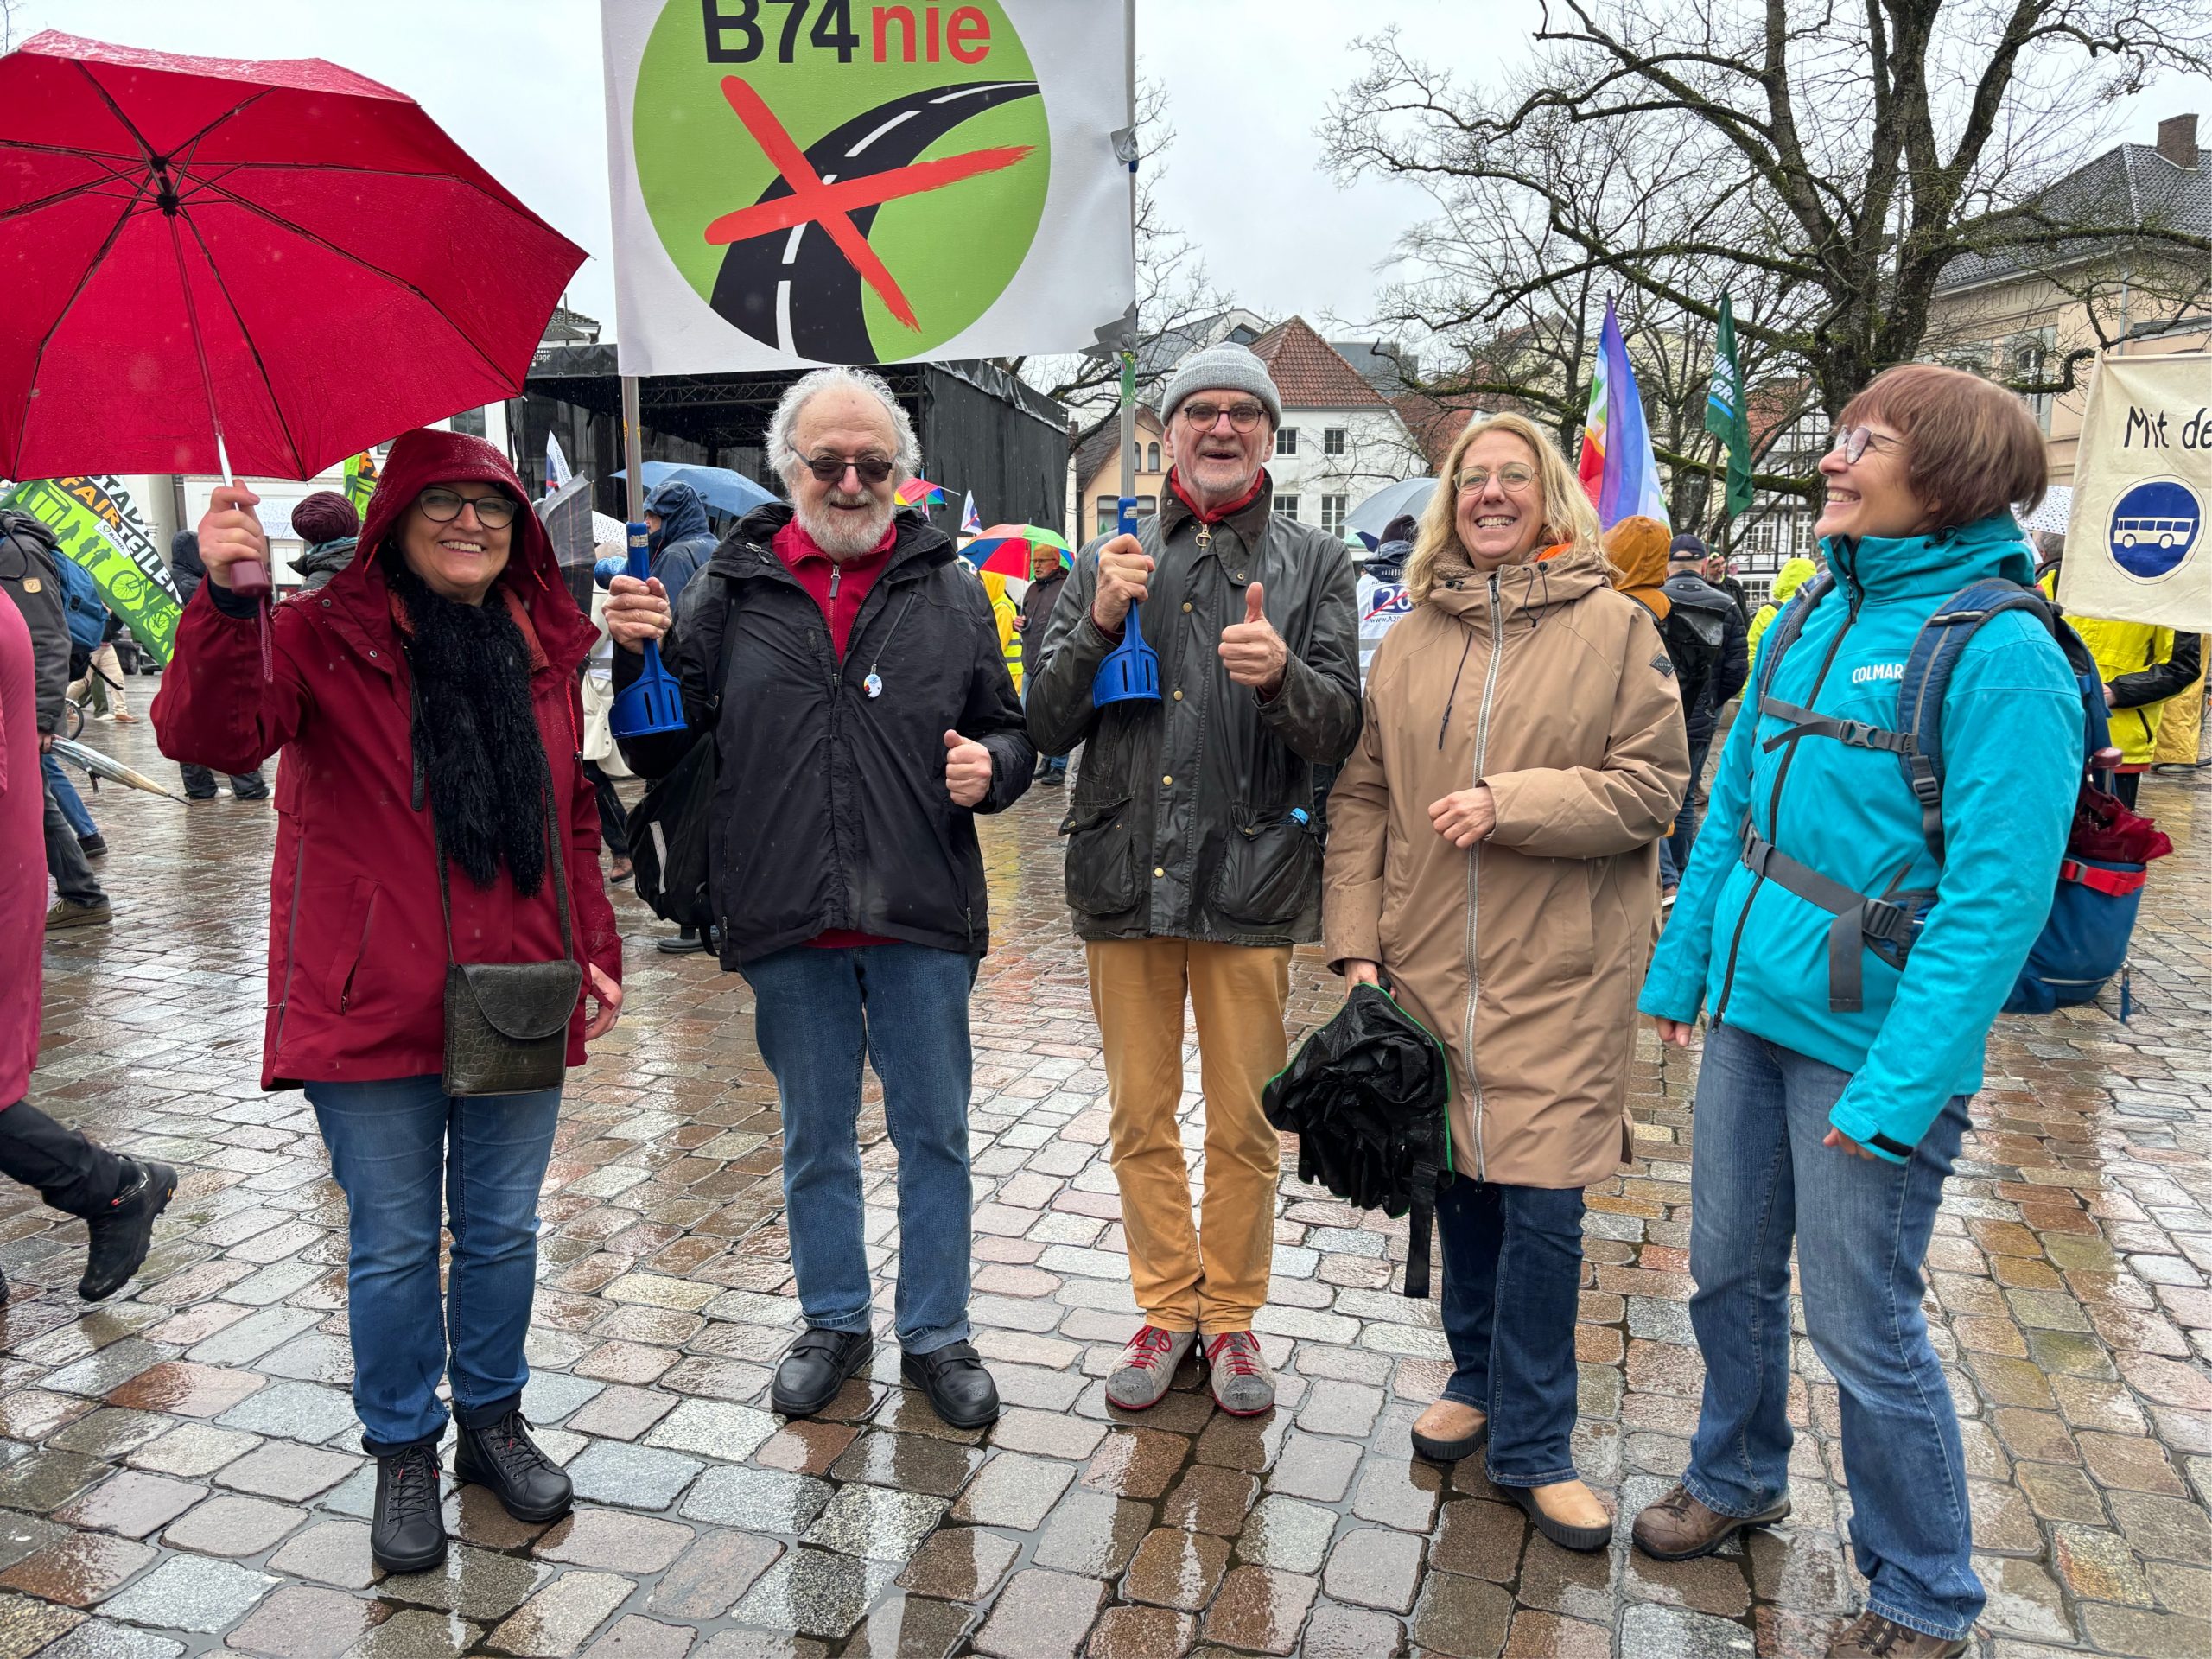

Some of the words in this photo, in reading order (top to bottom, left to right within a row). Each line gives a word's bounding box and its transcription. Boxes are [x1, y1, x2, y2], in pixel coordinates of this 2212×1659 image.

[702, 0, 860, 64] B74
[872, 0, 991, 64] nie
[2123, 405, 2170, 448] Mit
[90, 475, 149, 537] TAD
[1852, 664, 1904, 684] COLMAR
